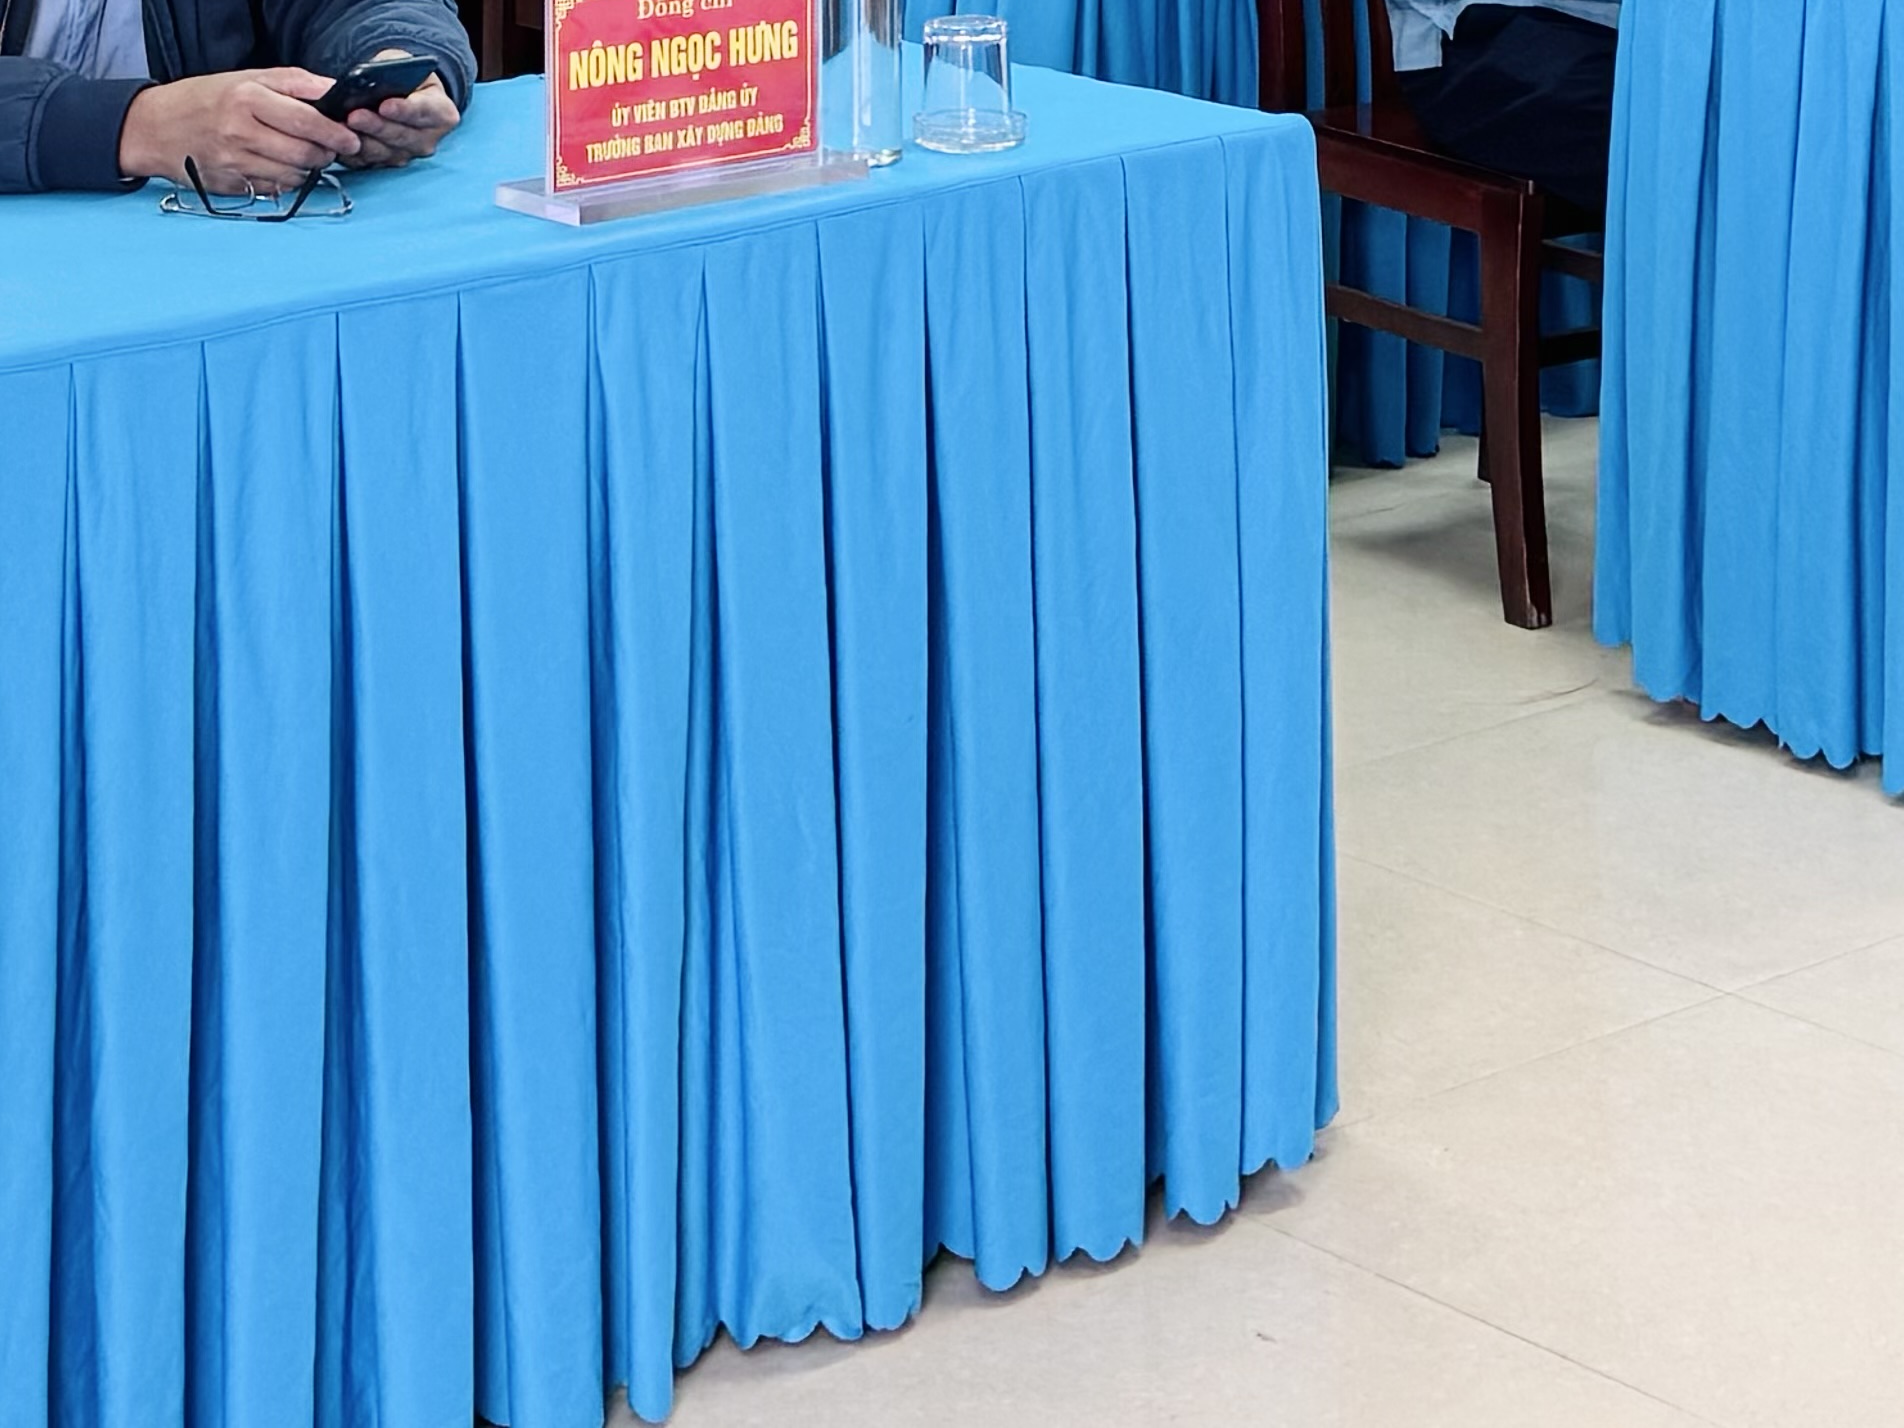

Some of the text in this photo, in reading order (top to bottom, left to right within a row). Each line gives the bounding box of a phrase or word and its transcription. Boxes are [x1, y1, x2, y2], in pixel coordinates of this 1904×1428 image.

[569, 19, 799, 91] NÔNG NGỌC HƯNG
